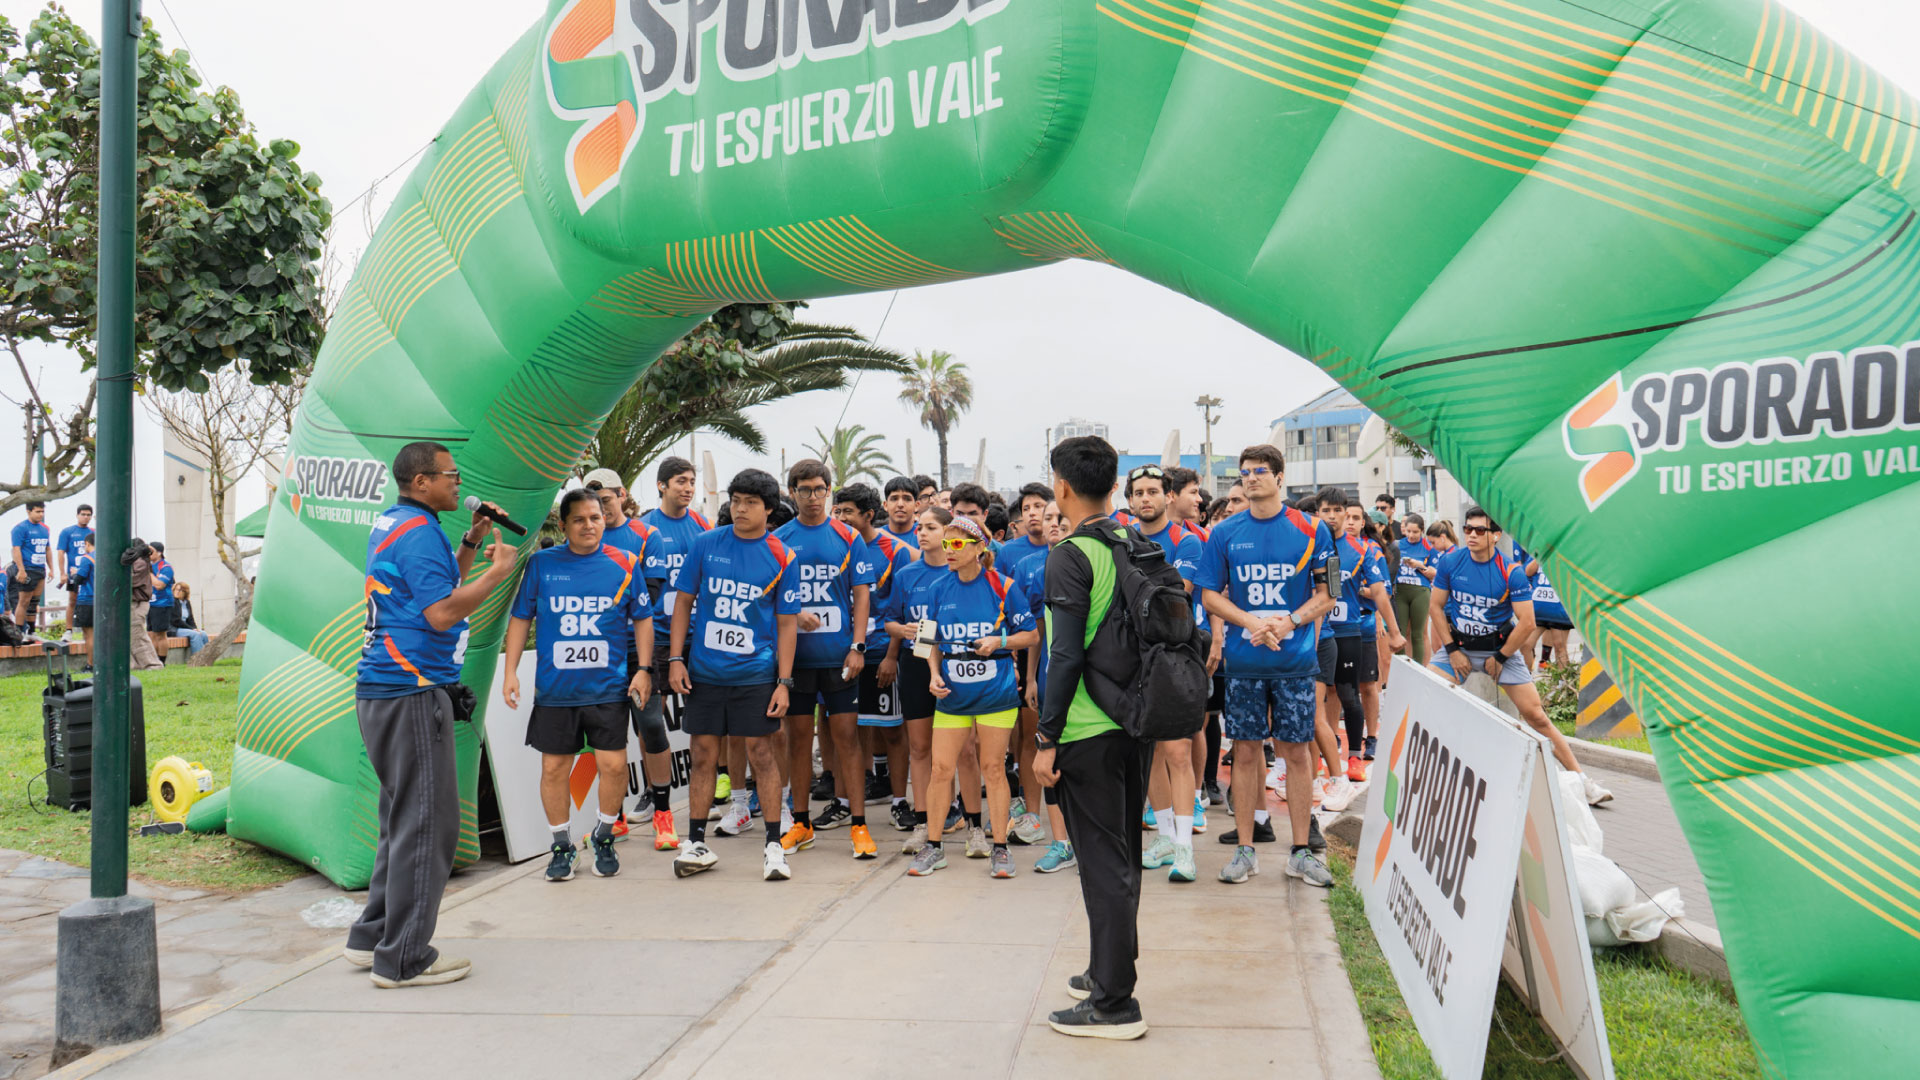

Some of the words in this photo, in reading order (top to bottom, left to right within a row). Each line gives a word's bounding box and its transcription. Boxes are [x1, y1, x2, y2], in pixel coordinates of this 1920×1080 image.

[664, 119, 705, 177] TU
[716, 77, 893, 168] ESFUERZO
[908, 45, 1004, 128] VALE
[296, 457, 387, 501] SPORADE
[1655, 464, 1691, 495] TU
[1701, 452, 1852, 493] ESFUERZO
[305, 503, 316, 520] TU
[315, 505, 353, 524] ESFUERZO
[1236, 563, 1296, 582] UDEP
[708, 577, 764, 601] UDEP
[1247, 582, 1287, 606] 8K
[1451, 590, 1499, 608] UDEP
[1536, 589, 1555, 600] 293
[549, 595, 613, 613] UDEP
[714, 596, 751, 623] 8K
[1459, 604, 1489, 623] 8K
[560, 613, 602, 637] 8K
[940, 622, 994, 640] UDEP
[1464, 623, 1489, 636] 064
[715, 628, 746, 648] 162
[564, 646, 599, 663] 240
[955, 662, 987, 678] 069
[879, 693, 890, 714] 9
[1396, 720, 1488, 921] SPORADE
[1393, 874, 1432, 970] ESFUERZO
[1426, 927, 1453, 1008] VALE
